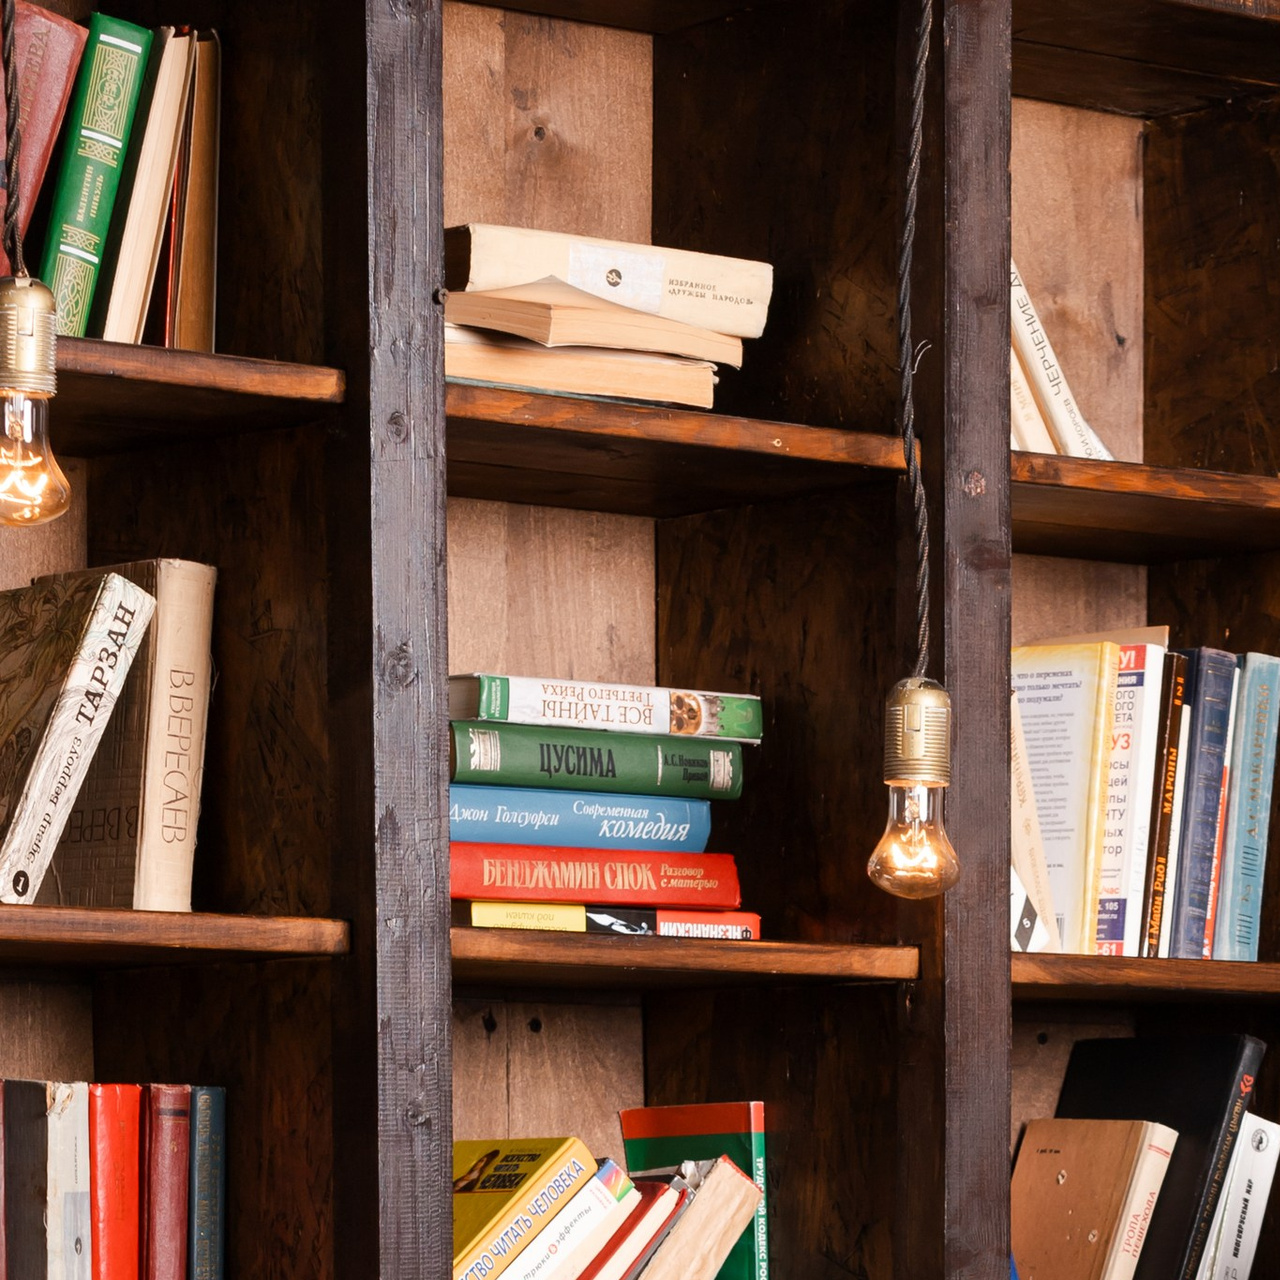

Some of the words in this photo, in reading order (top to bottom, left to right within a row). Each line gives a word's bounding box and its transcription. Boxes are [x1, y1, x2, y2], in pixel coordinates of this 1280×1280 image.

[76, 165, 94, 222] ВАЛЕНТИН
[90, 174, 104, 219] ПИКУЛЬ
[669, 278, 717, 291] ИЗБРАННОЕ
[1016, 295, 1062, 396] ЧЕРЧЕНИЕ
[1063, 397, 1084, 438] КОРОЕВ
[75, 600, 136, 728] ТАРЗАН
[541, 683, 585, 703] РЕЙХА
[541, 699, 604, 724] ТАЙНЫ
[588, 687, 652, 706] ТРЕТЬЕГО
[1115, 690, 1136, 701] ОГО
[619, 705, 653, 725] ВСЕ
[50, 735, 83, 808] Берроуз
[160, 667, 196, 845] В.ВЕРЕСАЕВ
[539, 743, 617, 778] ЦУСИМА
[1163, 748, 1177, 814] МАРОНЫ
[450, 803, 489, 823] Джон
[495, 806, 559, 830] Голсуорси
[572, 800, 649, 819] Современная
[598, 813, 690, 841] комедия
[483, 859, 600, 888] БЕНДЖАМИН
[604, 863, 657, 891] СПОК
[661, 863, 704, 877] Разговор
[668, 875, 719, 889] матерью
[1154, 864, 1166, 893] Рид
[1104, 901, 1119, 910] 105
[1150, 898, 1164, 938] Майн
[756, 1157, 765, 1215] ТРУДООЙ
[489, 1215, 534, 1257] ЧИТАТЬ
[527, 1157, 585, 1217] ЧЕЛОВЕКА
[1131, 1191, 1157, 1259] ПЕШЕХОДА
[523, 1252, 552, 1280] трюки
[556, 1206, 593, 1245] эффекты
[758, 1216, 767, 1260] КОДЕКС
[1121, 1212, 1142, 1254] ТРОПА
